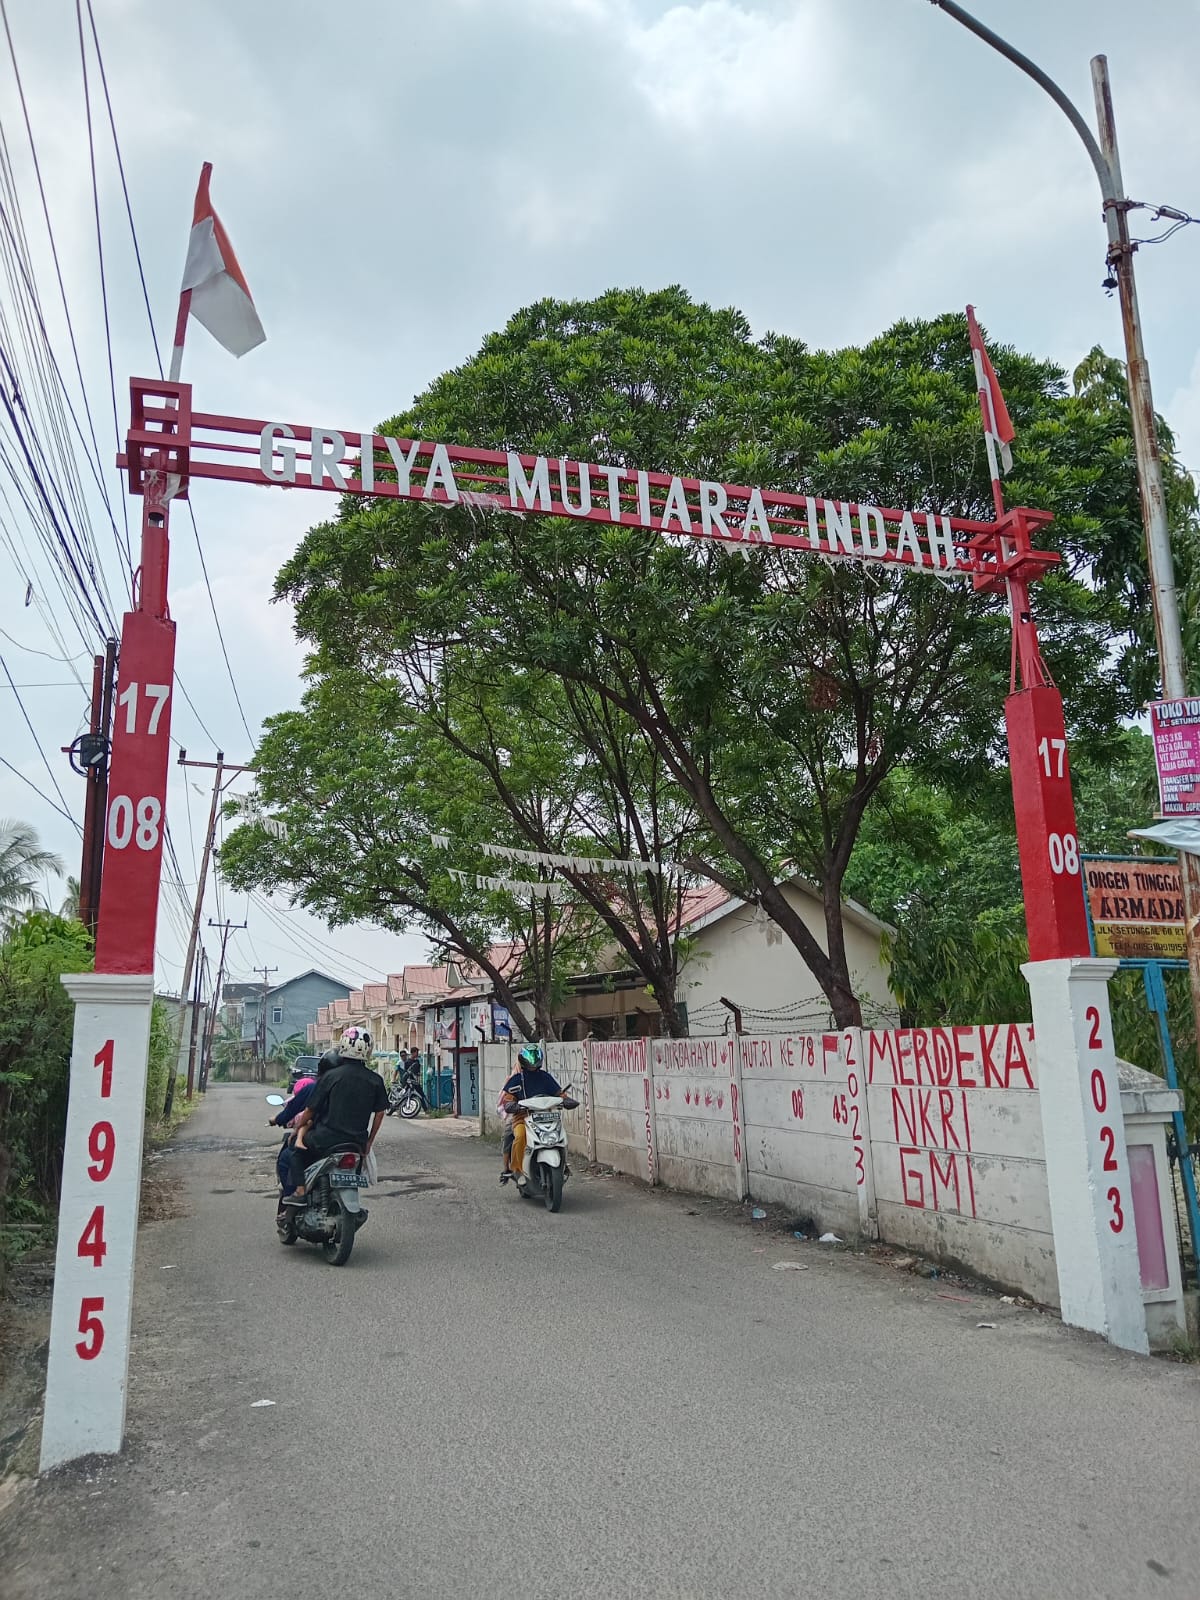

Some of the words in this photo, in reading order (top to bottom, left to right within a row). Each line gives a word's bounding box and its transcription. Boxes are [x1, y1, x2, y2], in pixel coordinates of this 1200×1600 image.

[260, 422, 460, 500] GRIYA
[505, 452, 773, 543] MUTIARA
[806, 496, 956, 567] INDAH
[119, 682, 170, 735] 17
[1154, 702, 1183, 720] TOKO
[1184, 700, 1200, 717] YO
[1038, 737, 1066, 778] 17
[108, 795, 161, 850] 08
[1048, 833, 1079, 875] 08
[1088, 870, 1130, 890] ORGEN
[664, 1041, 717, 1070] DIRGAHAYU
[780, 1038, 794, 1066] KE
[799, 1036, 815, 1067] 78
[790, 1088, 804, 1120] 08
[892, 1088, 971, 1153] NKRI
[900, 1146, 976, 1219] GMI
